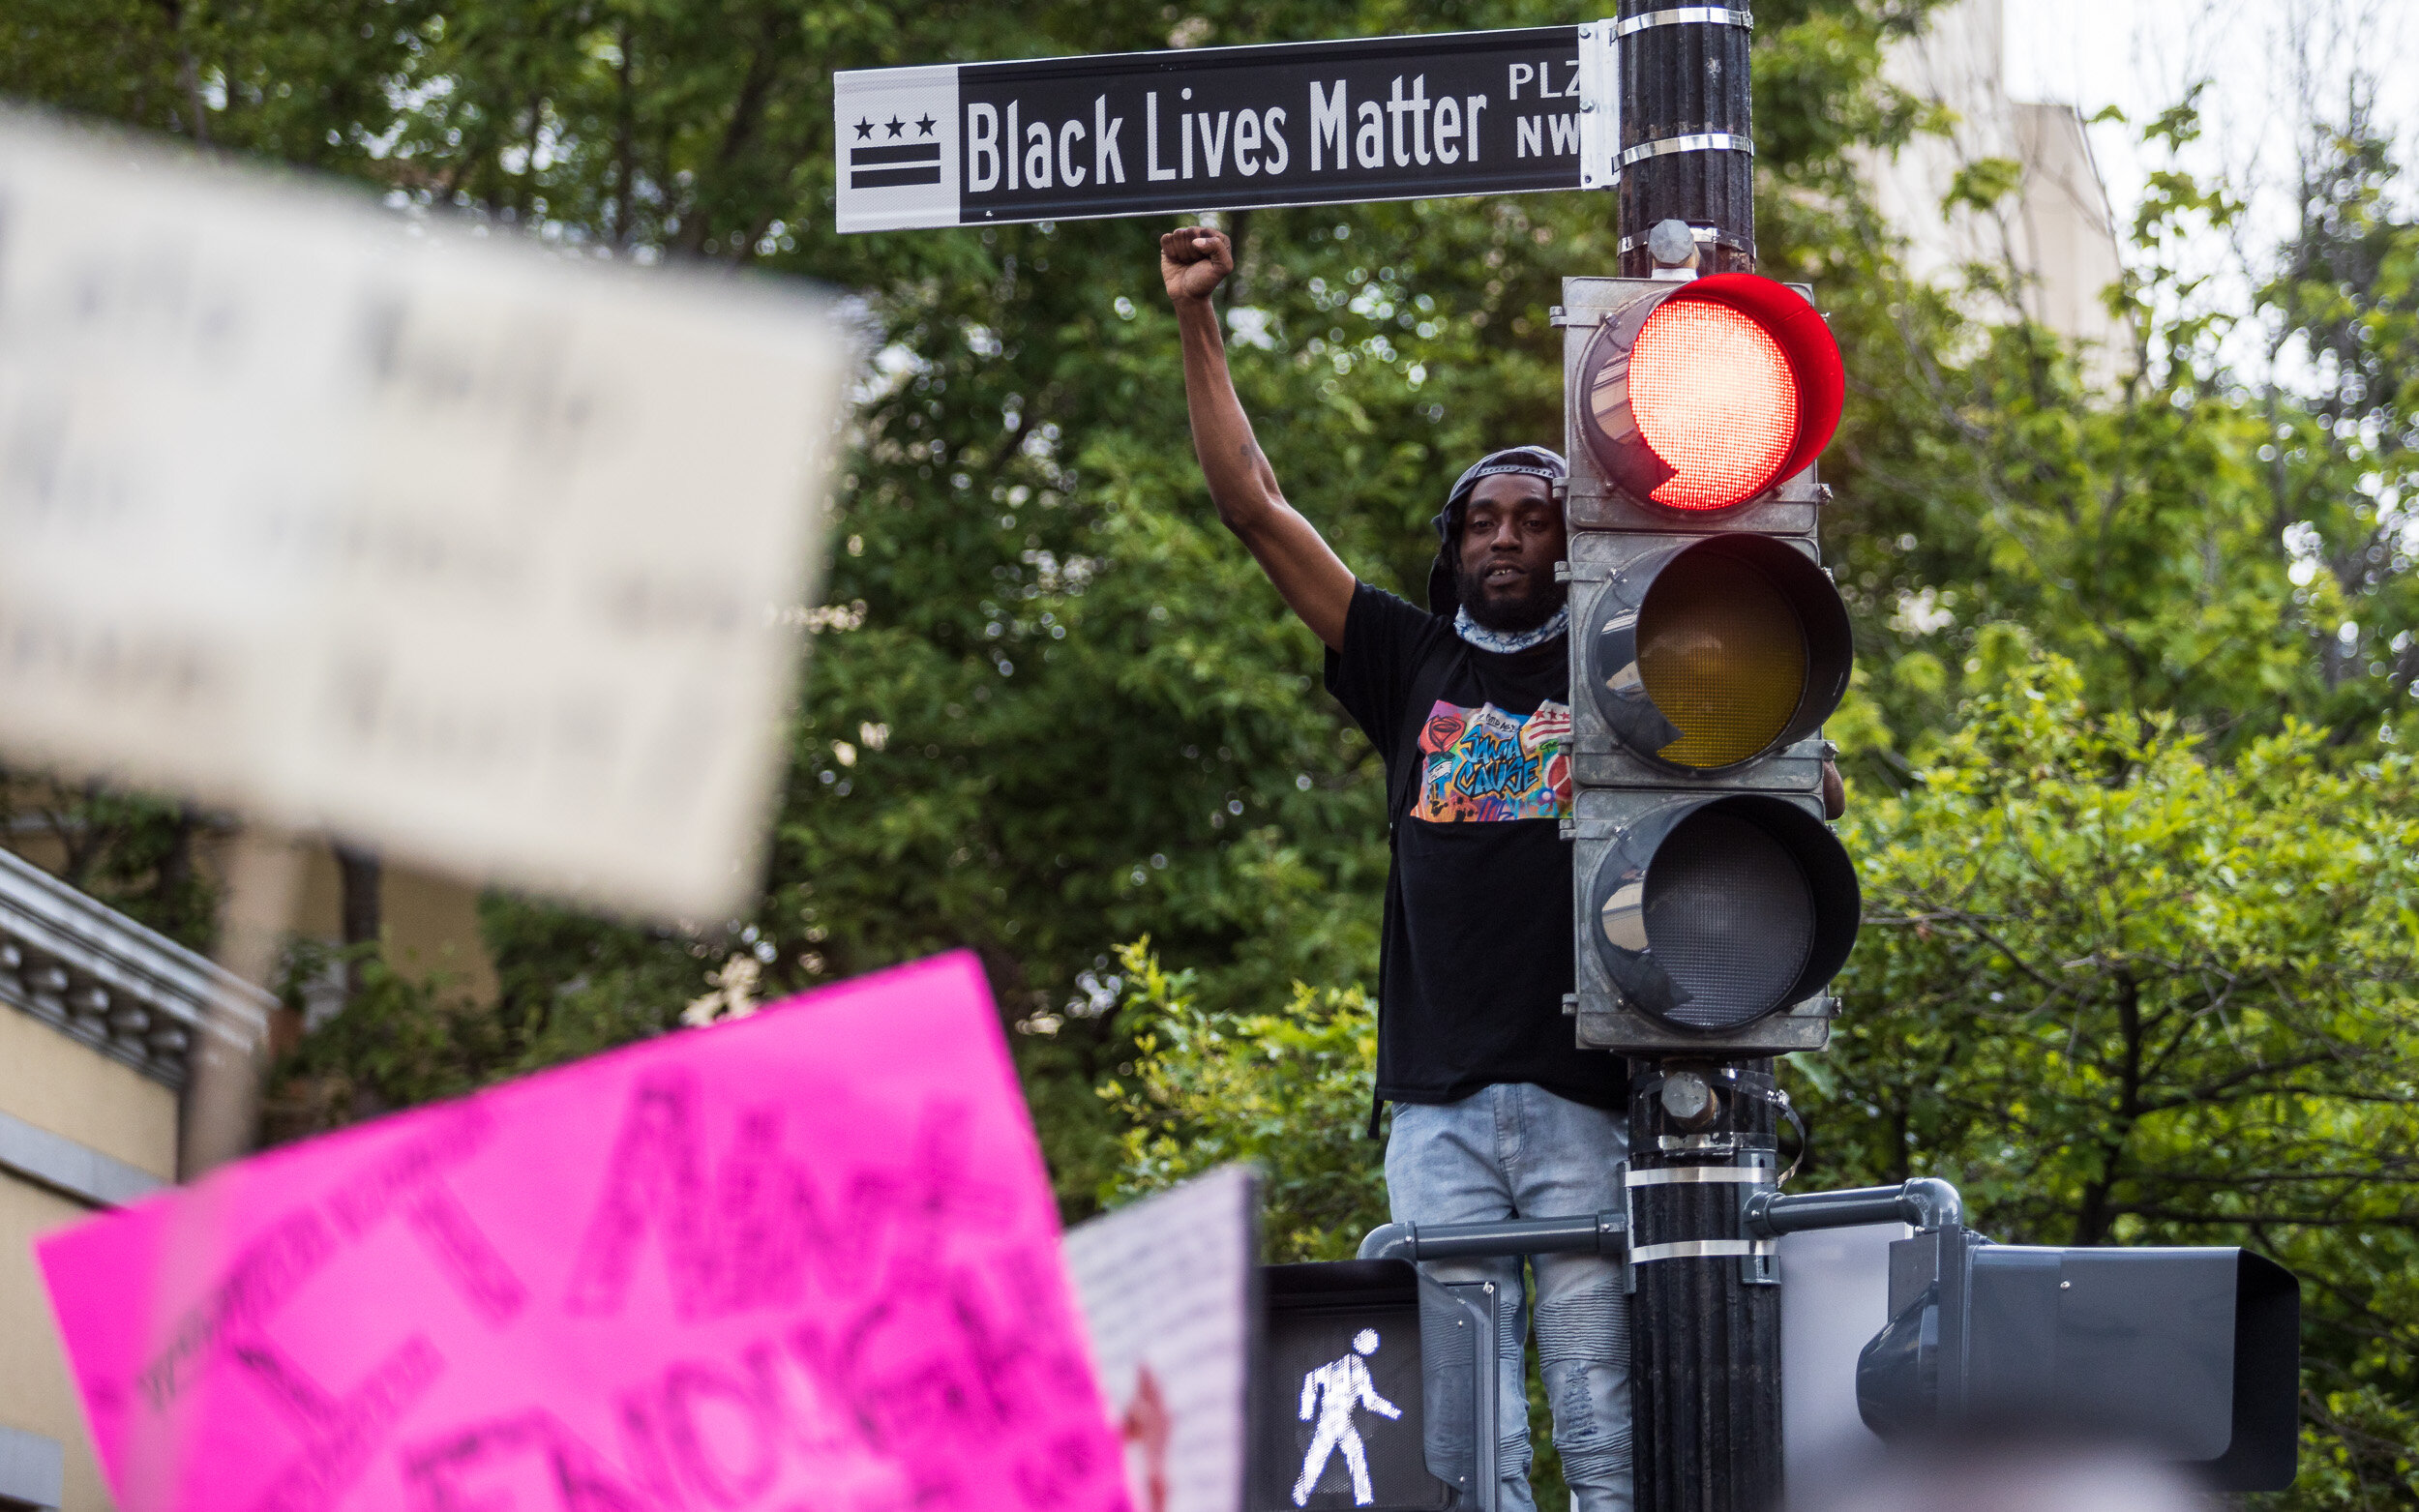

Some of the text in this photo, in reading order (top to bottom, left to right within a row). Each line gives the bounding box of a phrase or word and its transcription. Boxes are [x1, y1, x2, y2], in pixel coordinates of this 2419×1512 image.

[1509, 60, 1579, 101] PLZ
[969, 74, 1486, 193] Black Lives Matter
[1516, 113, 1580, 158] NW
[1454, 755, 1539, 797] CAUSE
